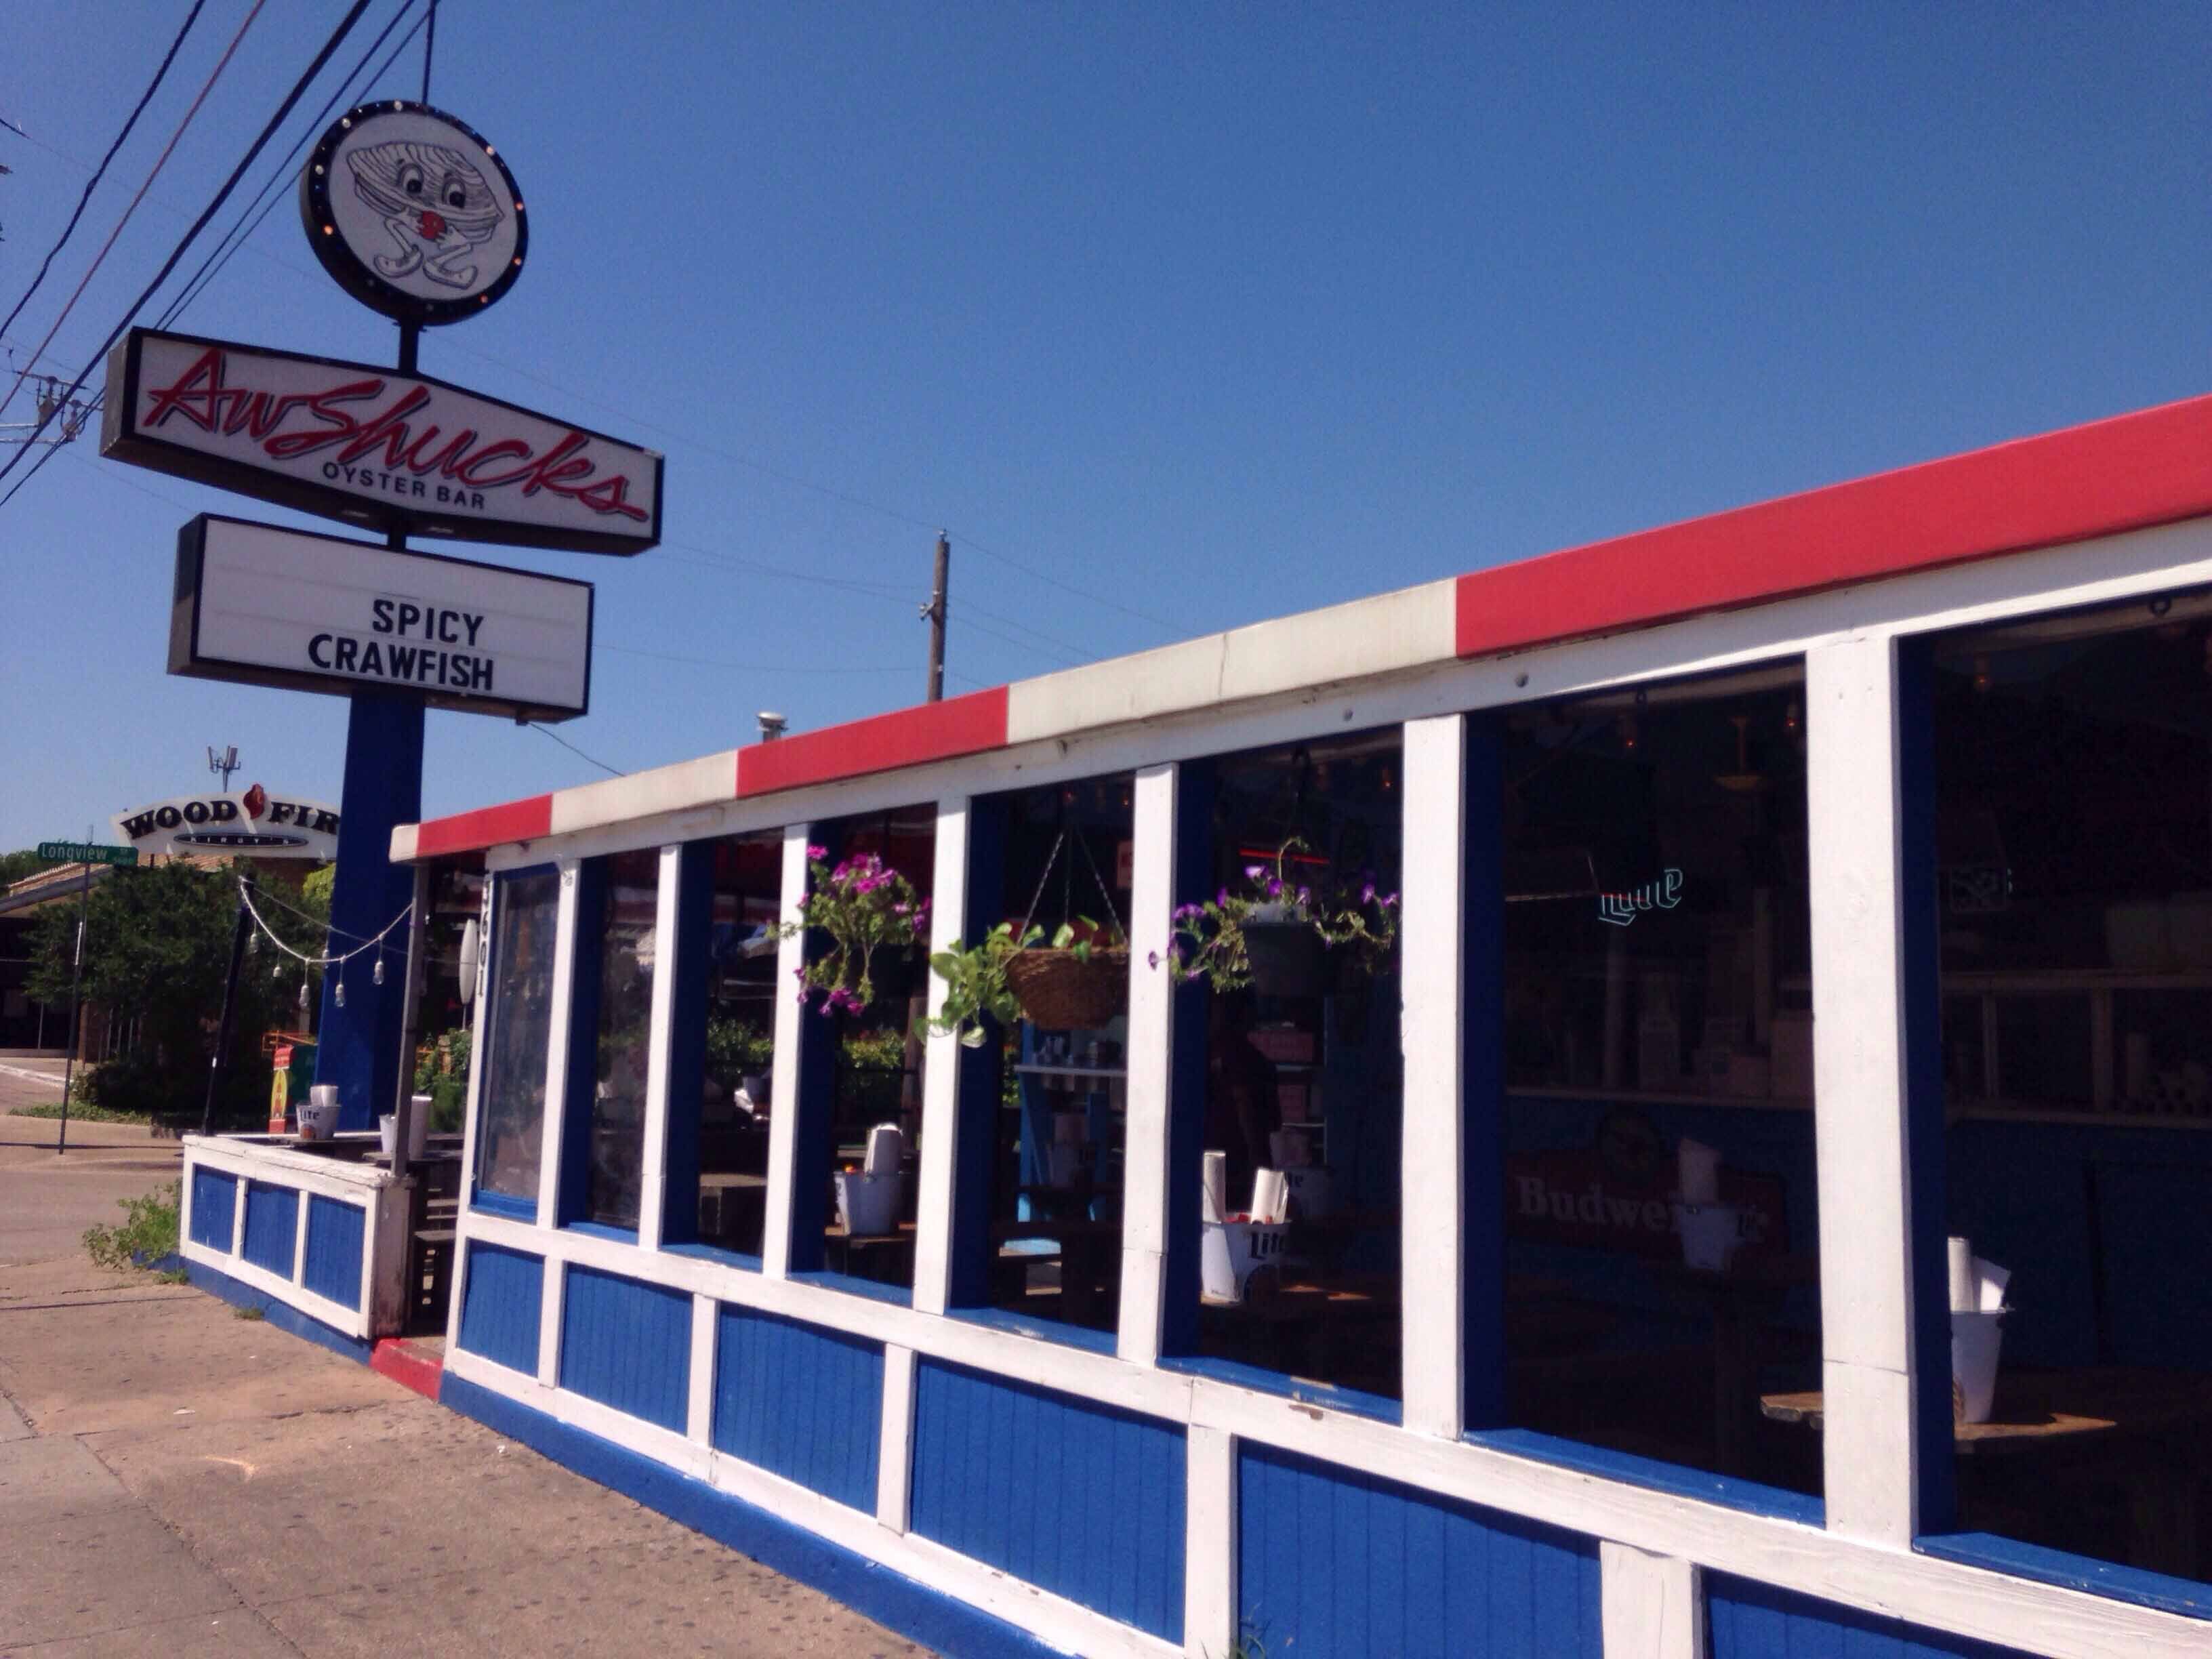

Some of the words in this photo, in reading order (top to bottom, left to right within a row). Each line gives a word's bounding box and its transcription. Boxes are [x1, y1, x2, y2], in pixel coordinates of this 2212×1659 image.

[323, 462, 426, 498] OYSTER
[436, 485, 485, 509] BAR
[373, 599, 484, 646] SPICY
[308, 633, 494, 691] CRAWFISH
[121, 800, 237, 840] WOOD
[267, 801, 340, 835] FIR
[42, 844, 108, 862] Longview
